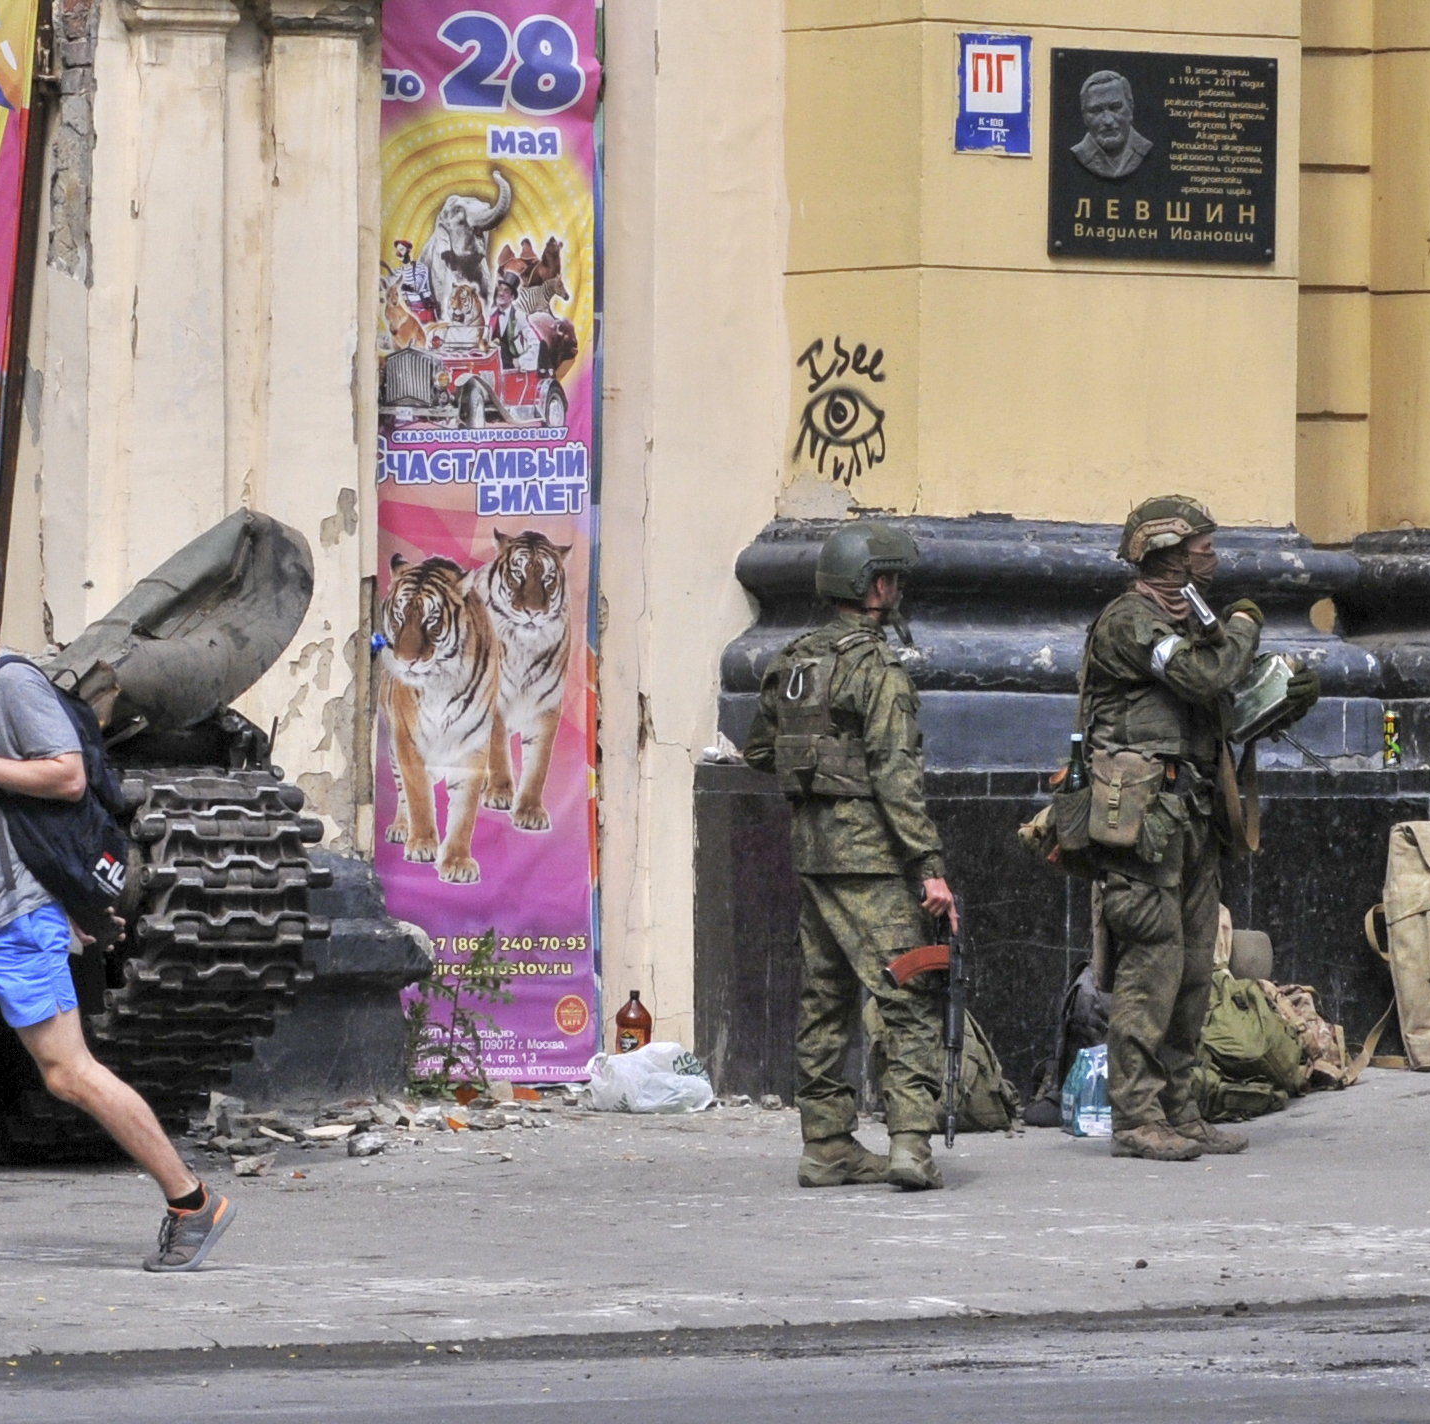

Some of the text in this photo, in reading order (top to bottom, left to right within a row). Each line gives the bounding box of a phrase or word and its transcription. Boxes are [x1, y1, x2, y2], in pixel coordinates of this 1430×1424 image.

[442, 15, 582, 111] 28
[972, 52, 1016, 93] ПГ
[1179, 76, 1201, 86] 1965
[1214, 78, 1237, 87] 2011
[491, 130, 558, 155] мая
[1074, 197, 1256, 225] ЛЕВШИН
[1074, 222, 1255, 244] Владилен Иванович
[392, 428, 567, 443] СКАЗОЧНОЕ ЦИРКОВОЕ ШОУ
[479, 482, 585, 513] БИЛЕТ
[499, 936, 587, 952] 240-70-93
[479, 1039, 516, 1051] 109012
[527, 1039, 569, 1051] Москва,
[527, 1066, 548, 1076] КПП
